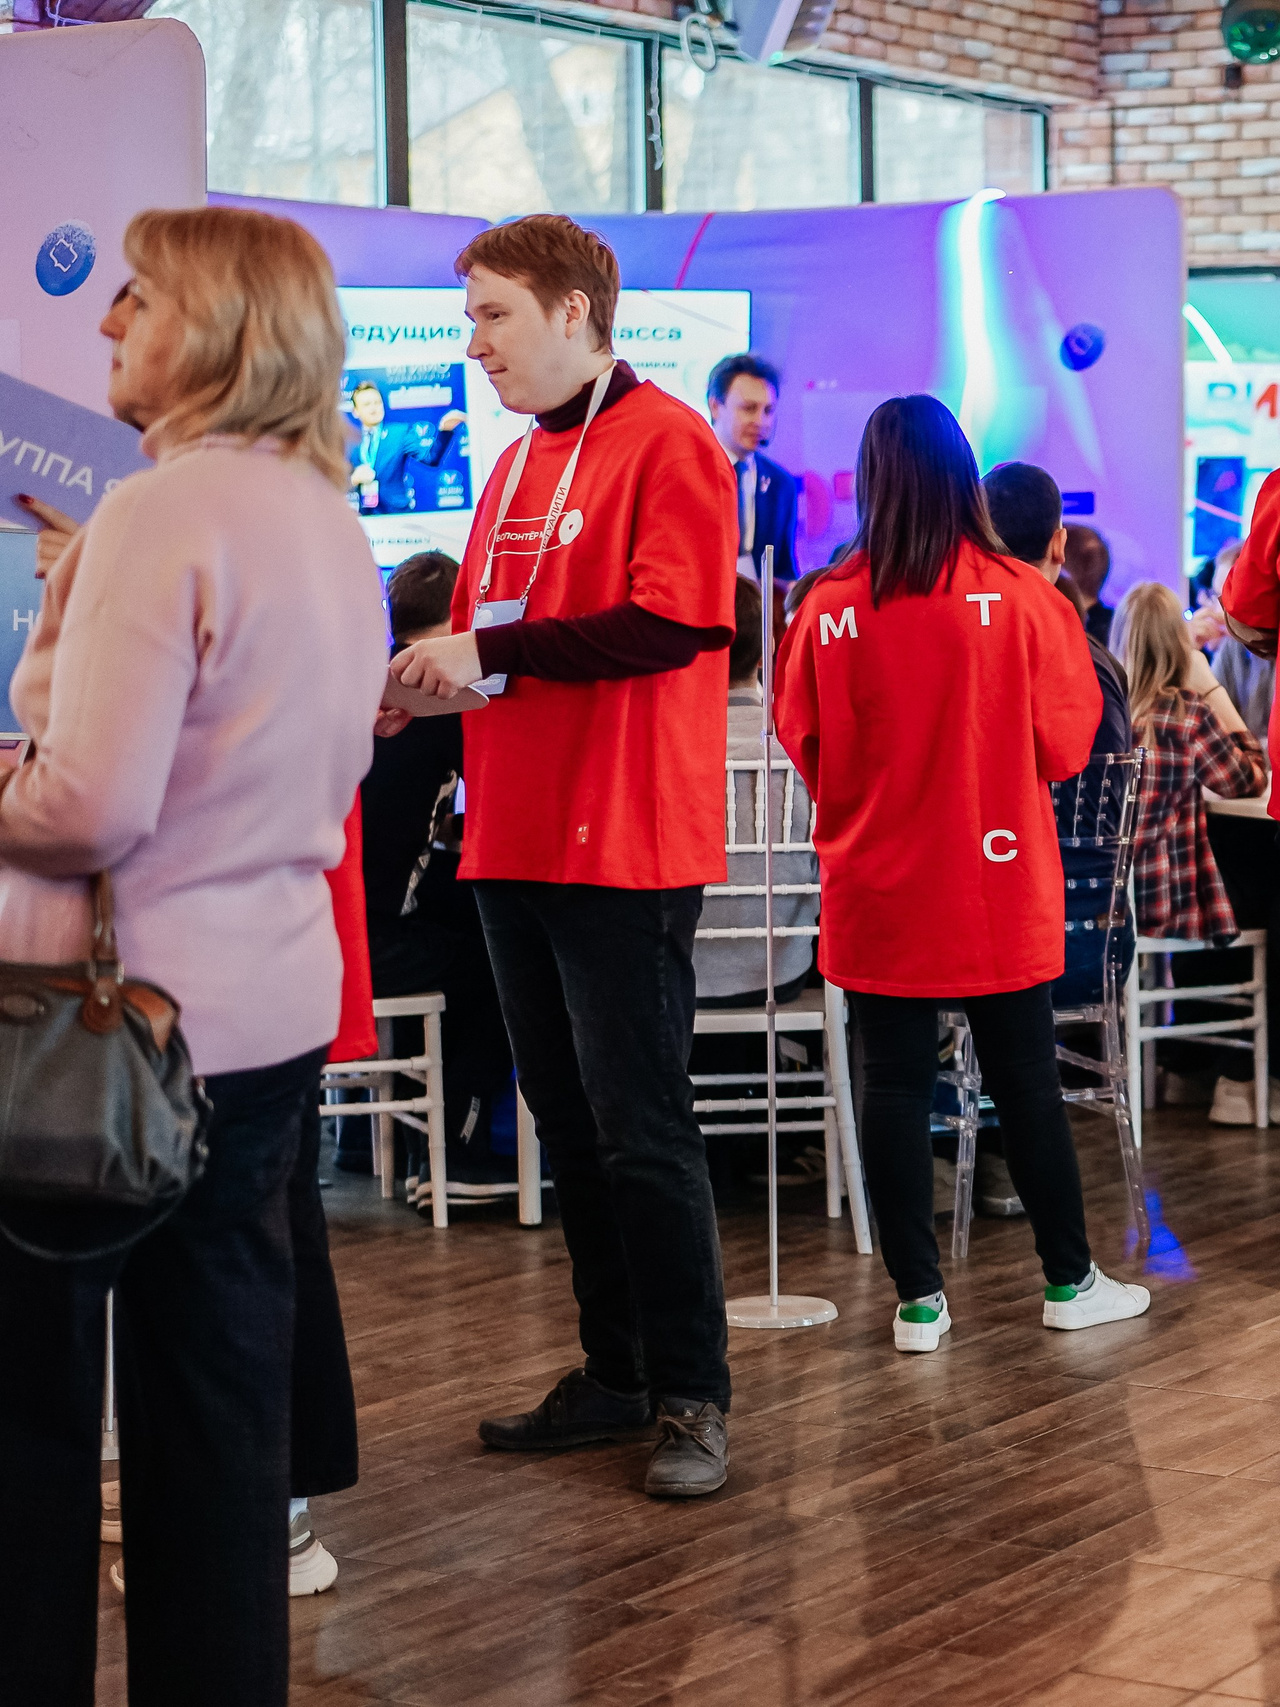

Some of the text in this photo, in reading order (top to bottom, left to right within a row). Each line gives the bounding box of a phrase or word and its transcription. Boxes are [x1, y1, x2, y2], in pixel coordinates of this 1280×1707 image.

[819, 593, 1002, 645] М Т
[982, 829, 1018, 862] С
